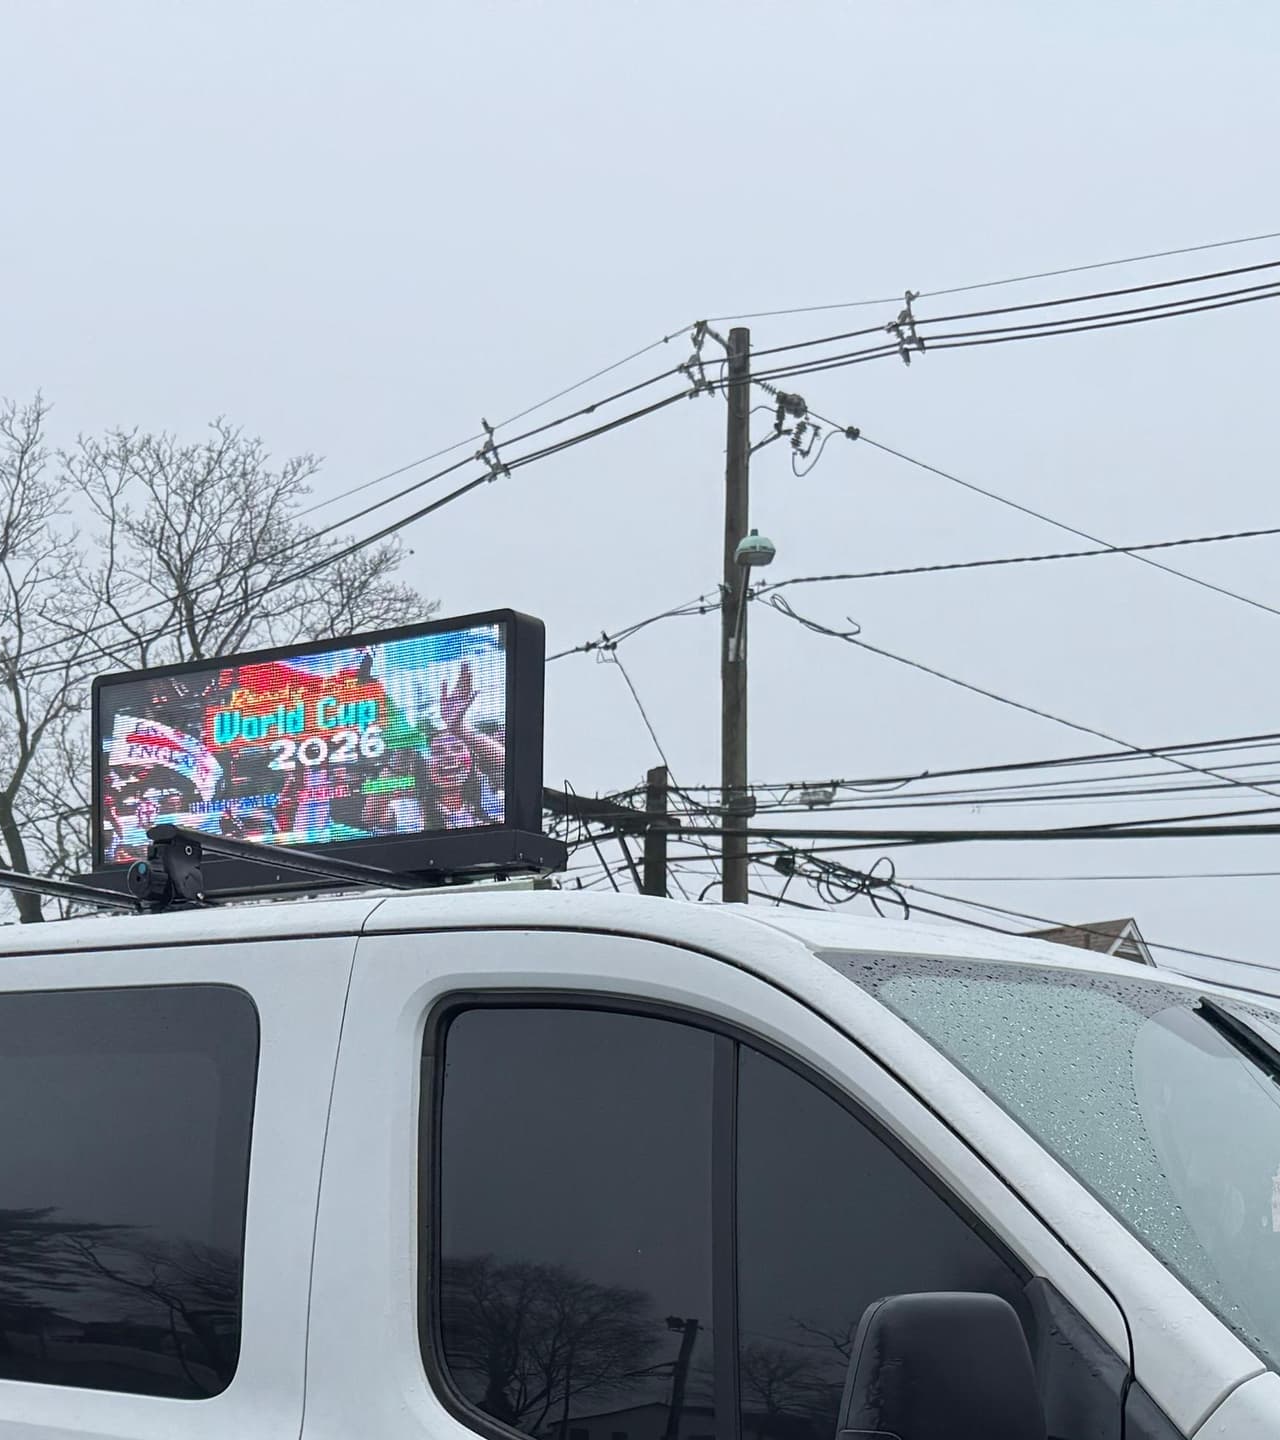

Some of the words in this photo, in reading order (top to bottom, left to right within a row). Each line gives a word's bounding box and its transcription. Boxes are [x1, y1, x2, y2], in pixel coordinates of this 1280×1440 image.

[213, 703, 305, 746] World
[316, 696, 378, 732] Cup
[267, 726, 386, 771] 2026
